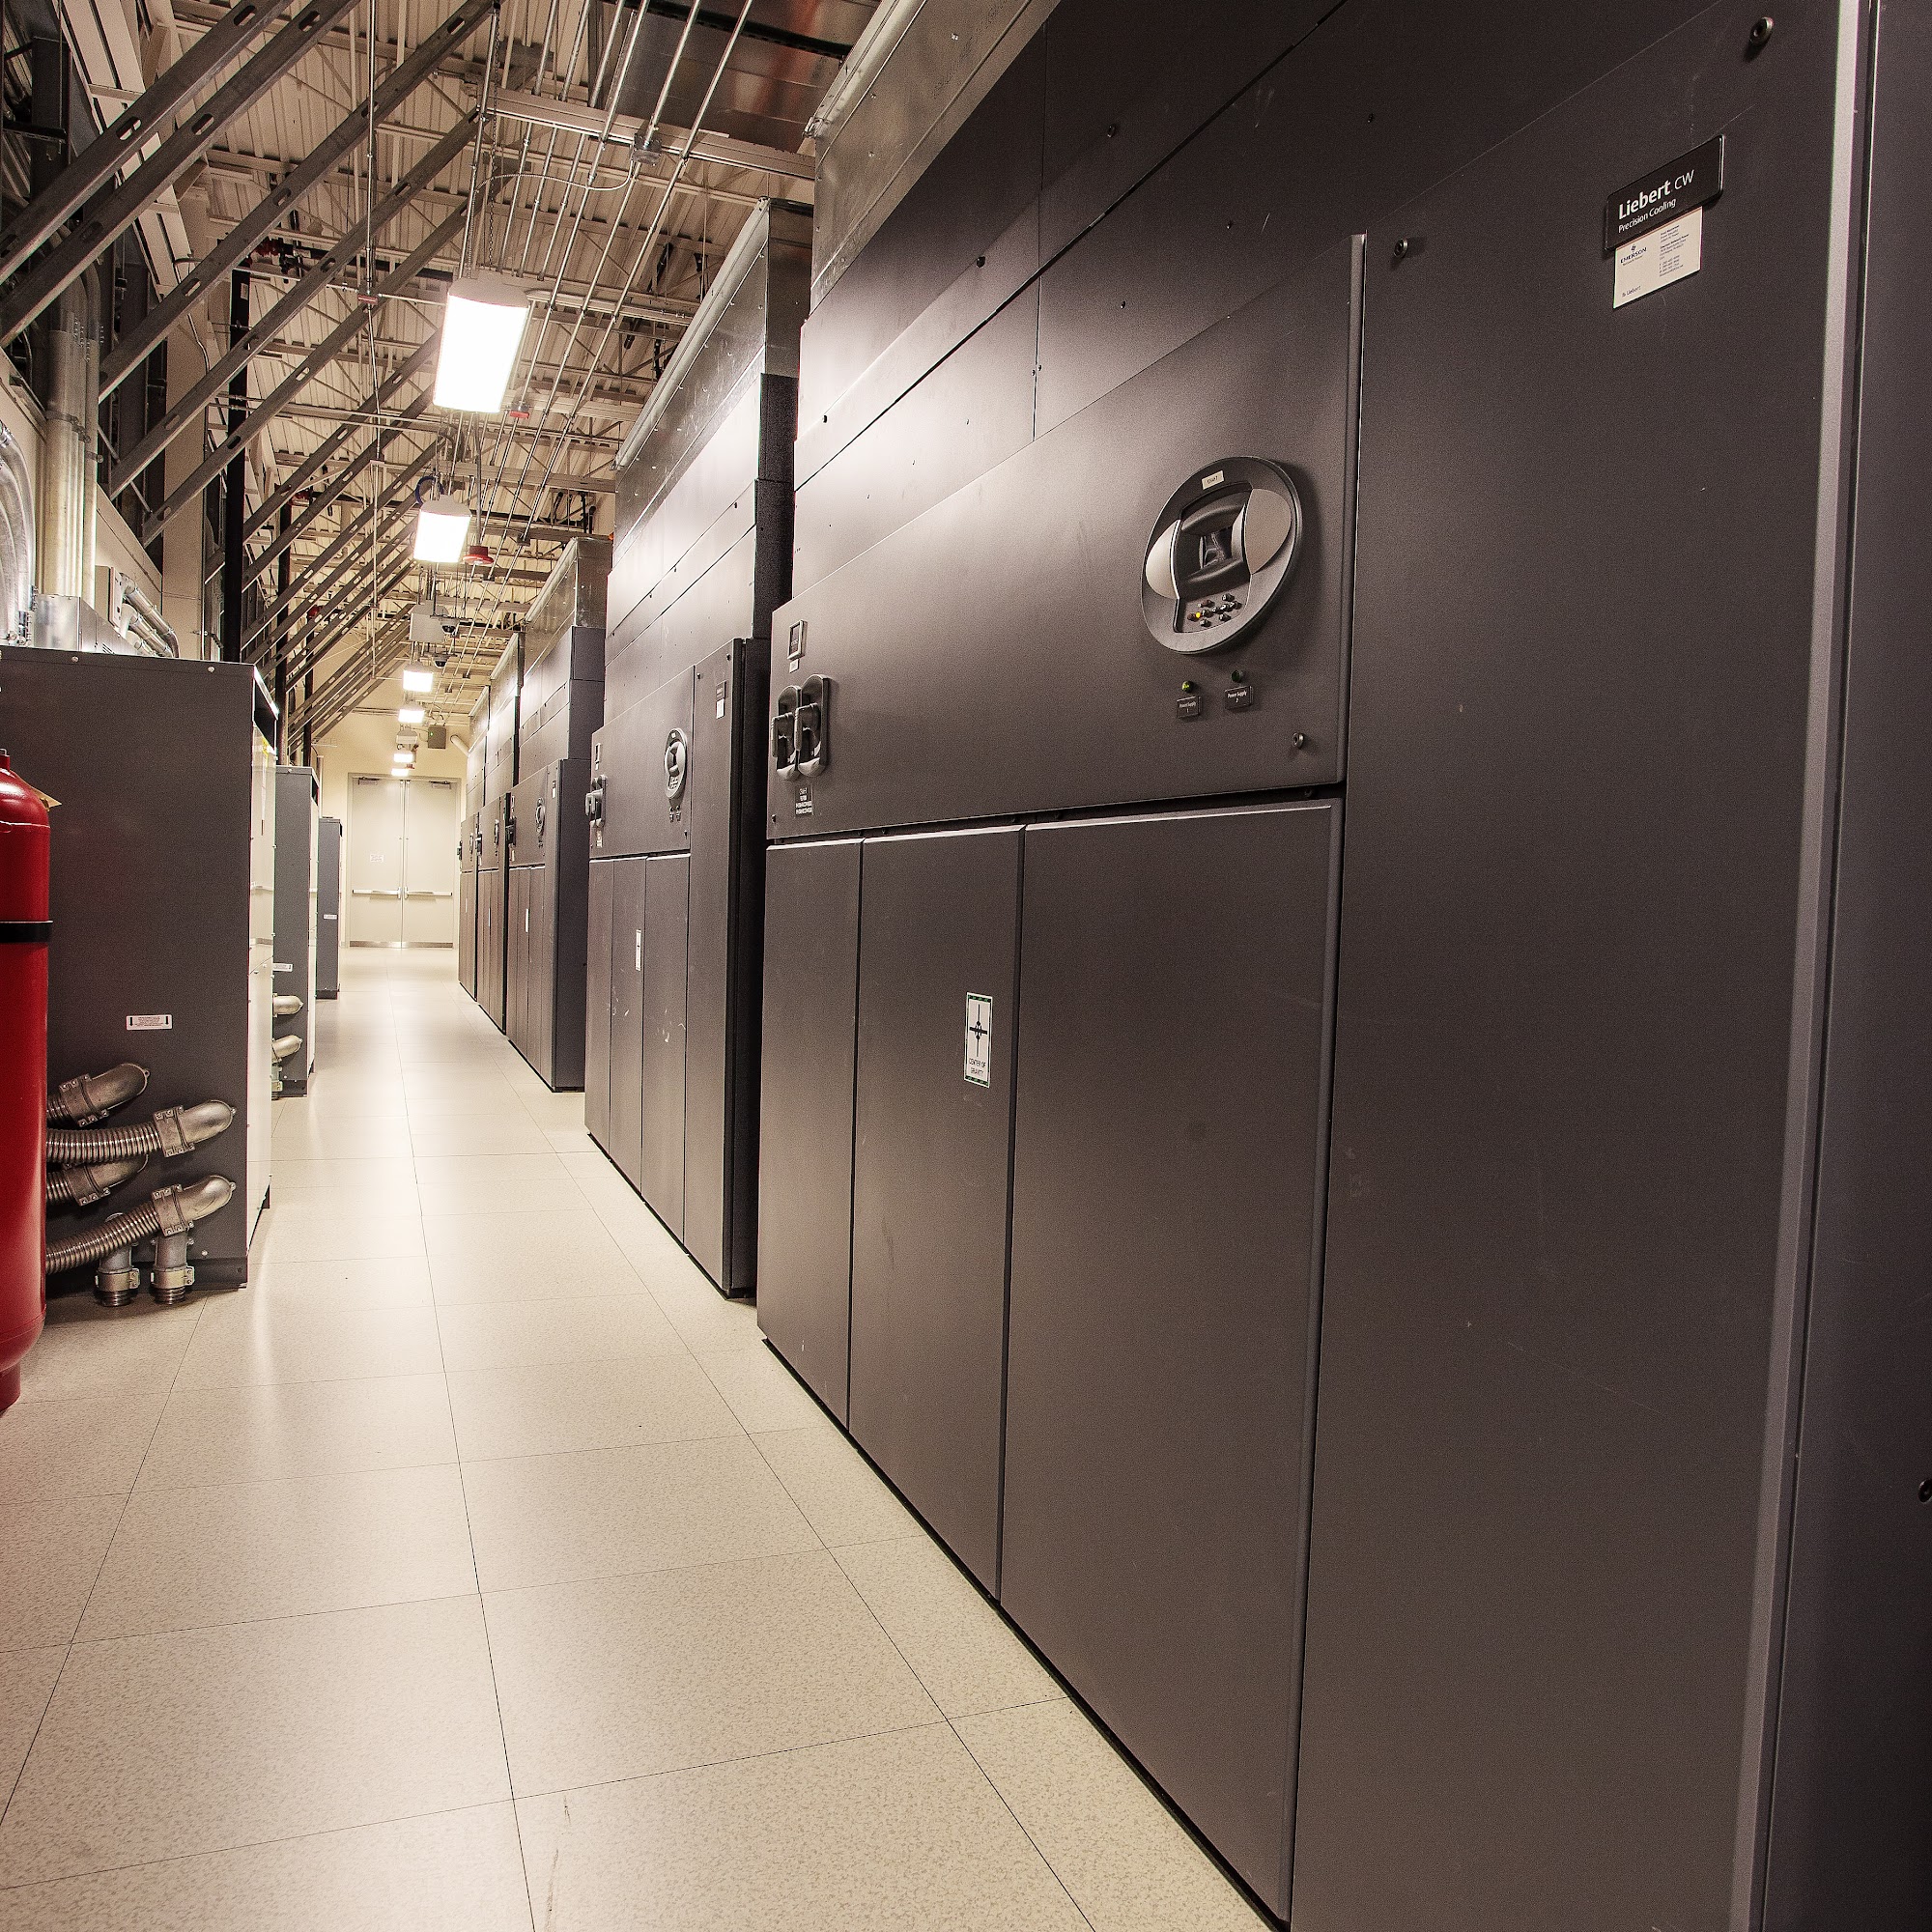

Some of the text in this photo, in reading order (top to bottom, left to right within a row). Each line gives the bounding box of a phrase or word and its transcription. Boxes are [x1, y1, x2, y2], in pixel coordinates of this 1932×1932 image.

[1618, 169, 1694, 220] Liebert CW
[1618, 198, 1677, 234] Precision Cooling
[1620, 246, 1647, 264] EMERSON
